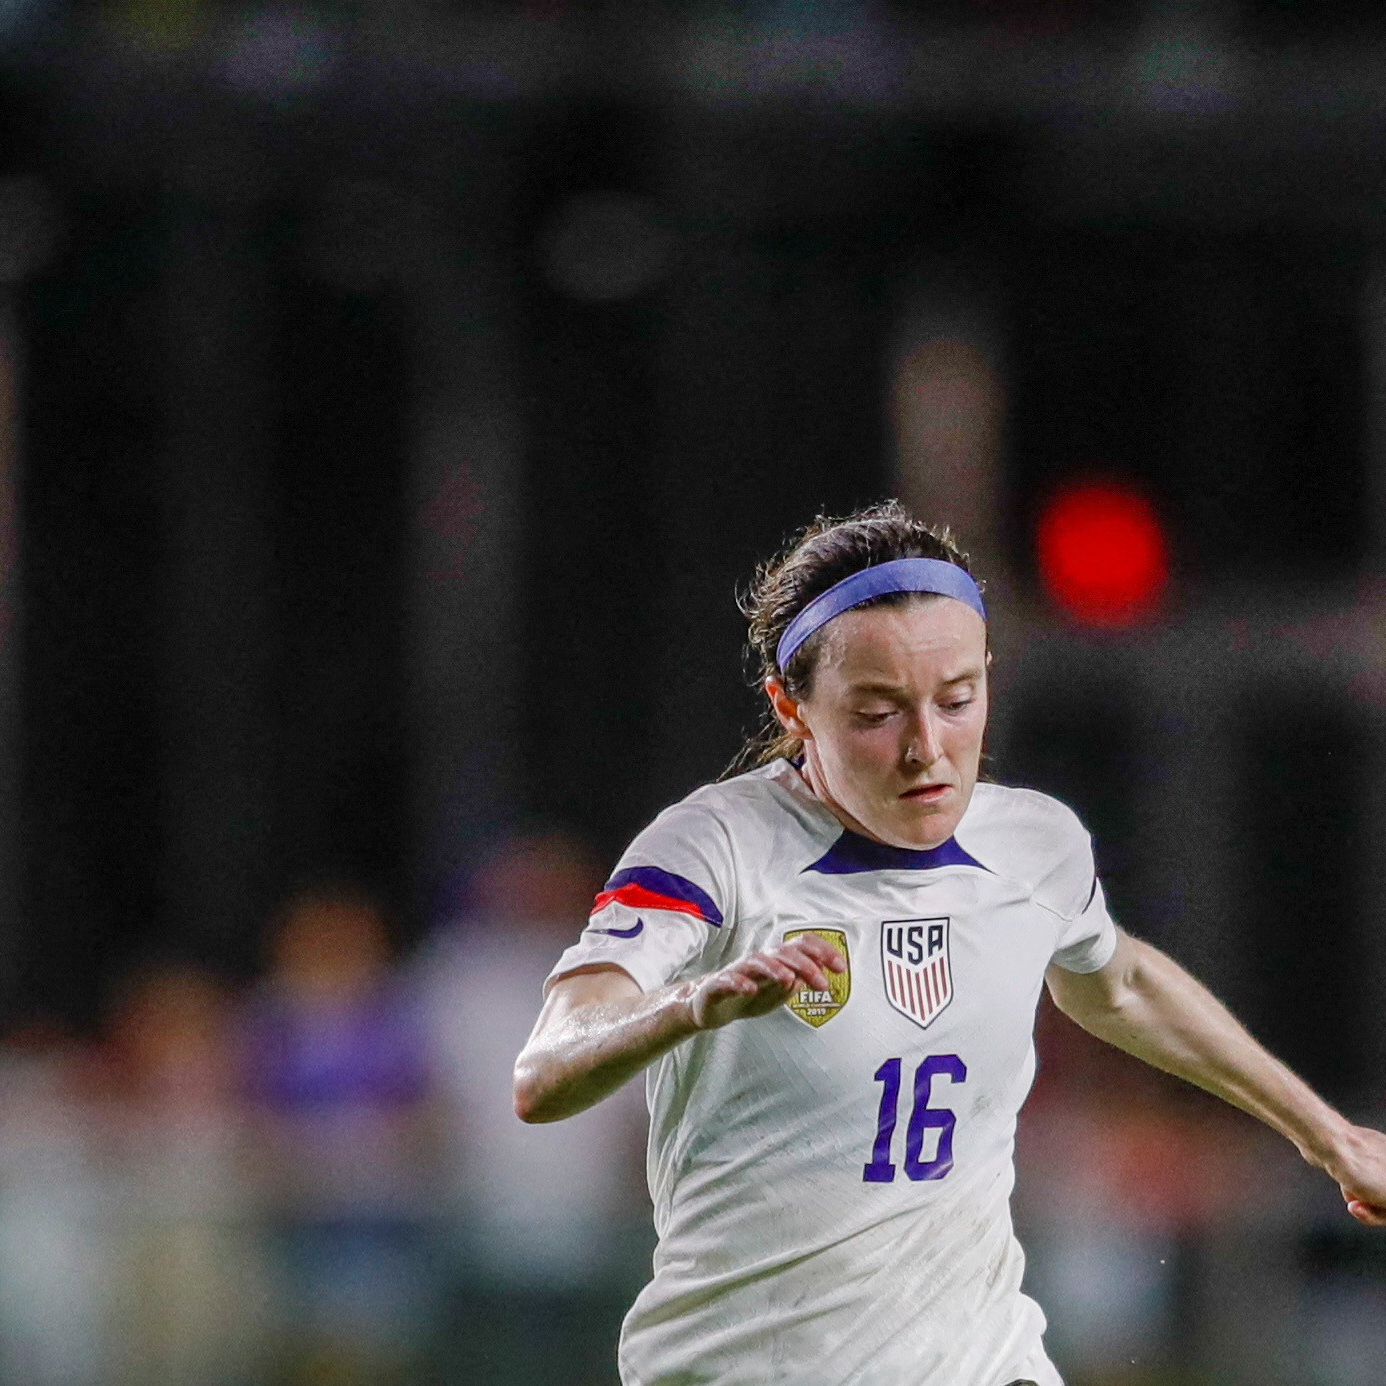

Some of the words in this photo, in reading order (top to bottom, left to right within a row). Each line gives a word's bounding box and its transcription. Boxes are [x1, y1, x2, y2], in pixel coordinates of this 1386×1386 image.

[887, 924, 943, 966] USA
[800, 990, 832, 1004] FIFA
[806, 1008, 827, 1016] 2019
[862, 1054, 967, 1182] 16
